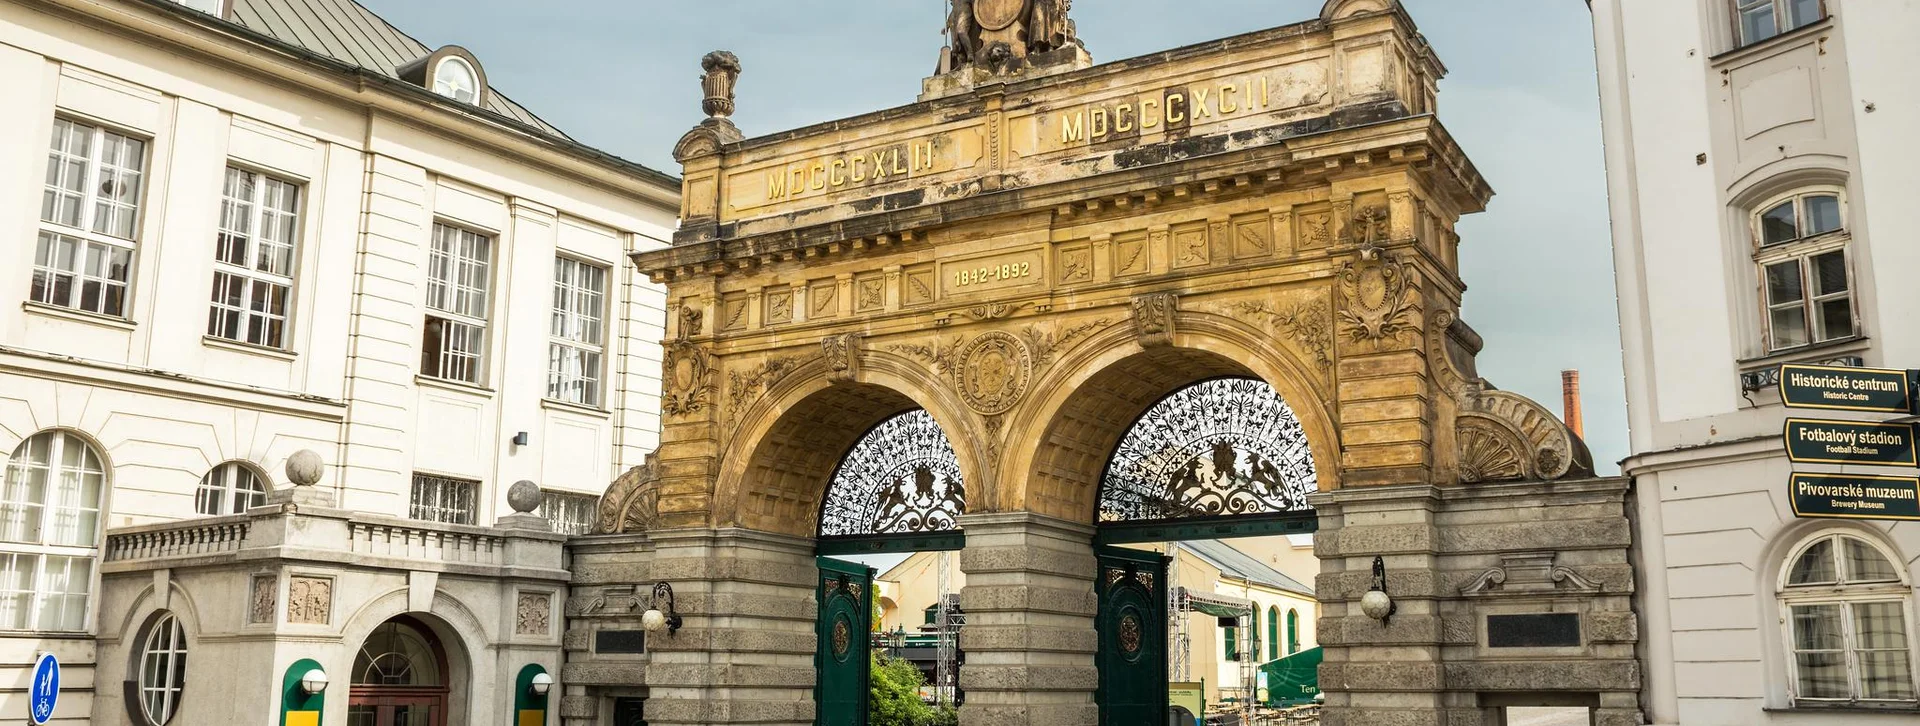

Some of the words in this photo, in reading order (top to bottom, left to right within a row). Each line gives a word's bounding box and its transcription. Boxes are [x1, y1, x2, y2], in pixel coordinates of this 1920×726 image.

[1062, 76, 1268, 143] MDCCCXCII
[768, 141, 932, 200] MDCCCXLII
[955, 261, 1029, 287] 1842-1892
[1791, 373, 1849, 389] Historické
[1852, 378, 1898, 392] centrum
[1823, 391, 1848, 400] Historic
[1848, 392, 1869, 401] Centre
[1800, 427, 1856, 446] Fotbalový
[1859, 430, 1902, 445] stadion
[1826, 445, 1851, 454] Football
[1852, 446, 1878, 455] Stadium
[1799, 482, 1863, 498] Pivovarské
[1866, 486, 1915, 500] muzeum
[1831, 499, 1857, 510] Brewery
[1858, 500, 1885, 509] Museum
[1300, 684, 1316, 693] Ten
